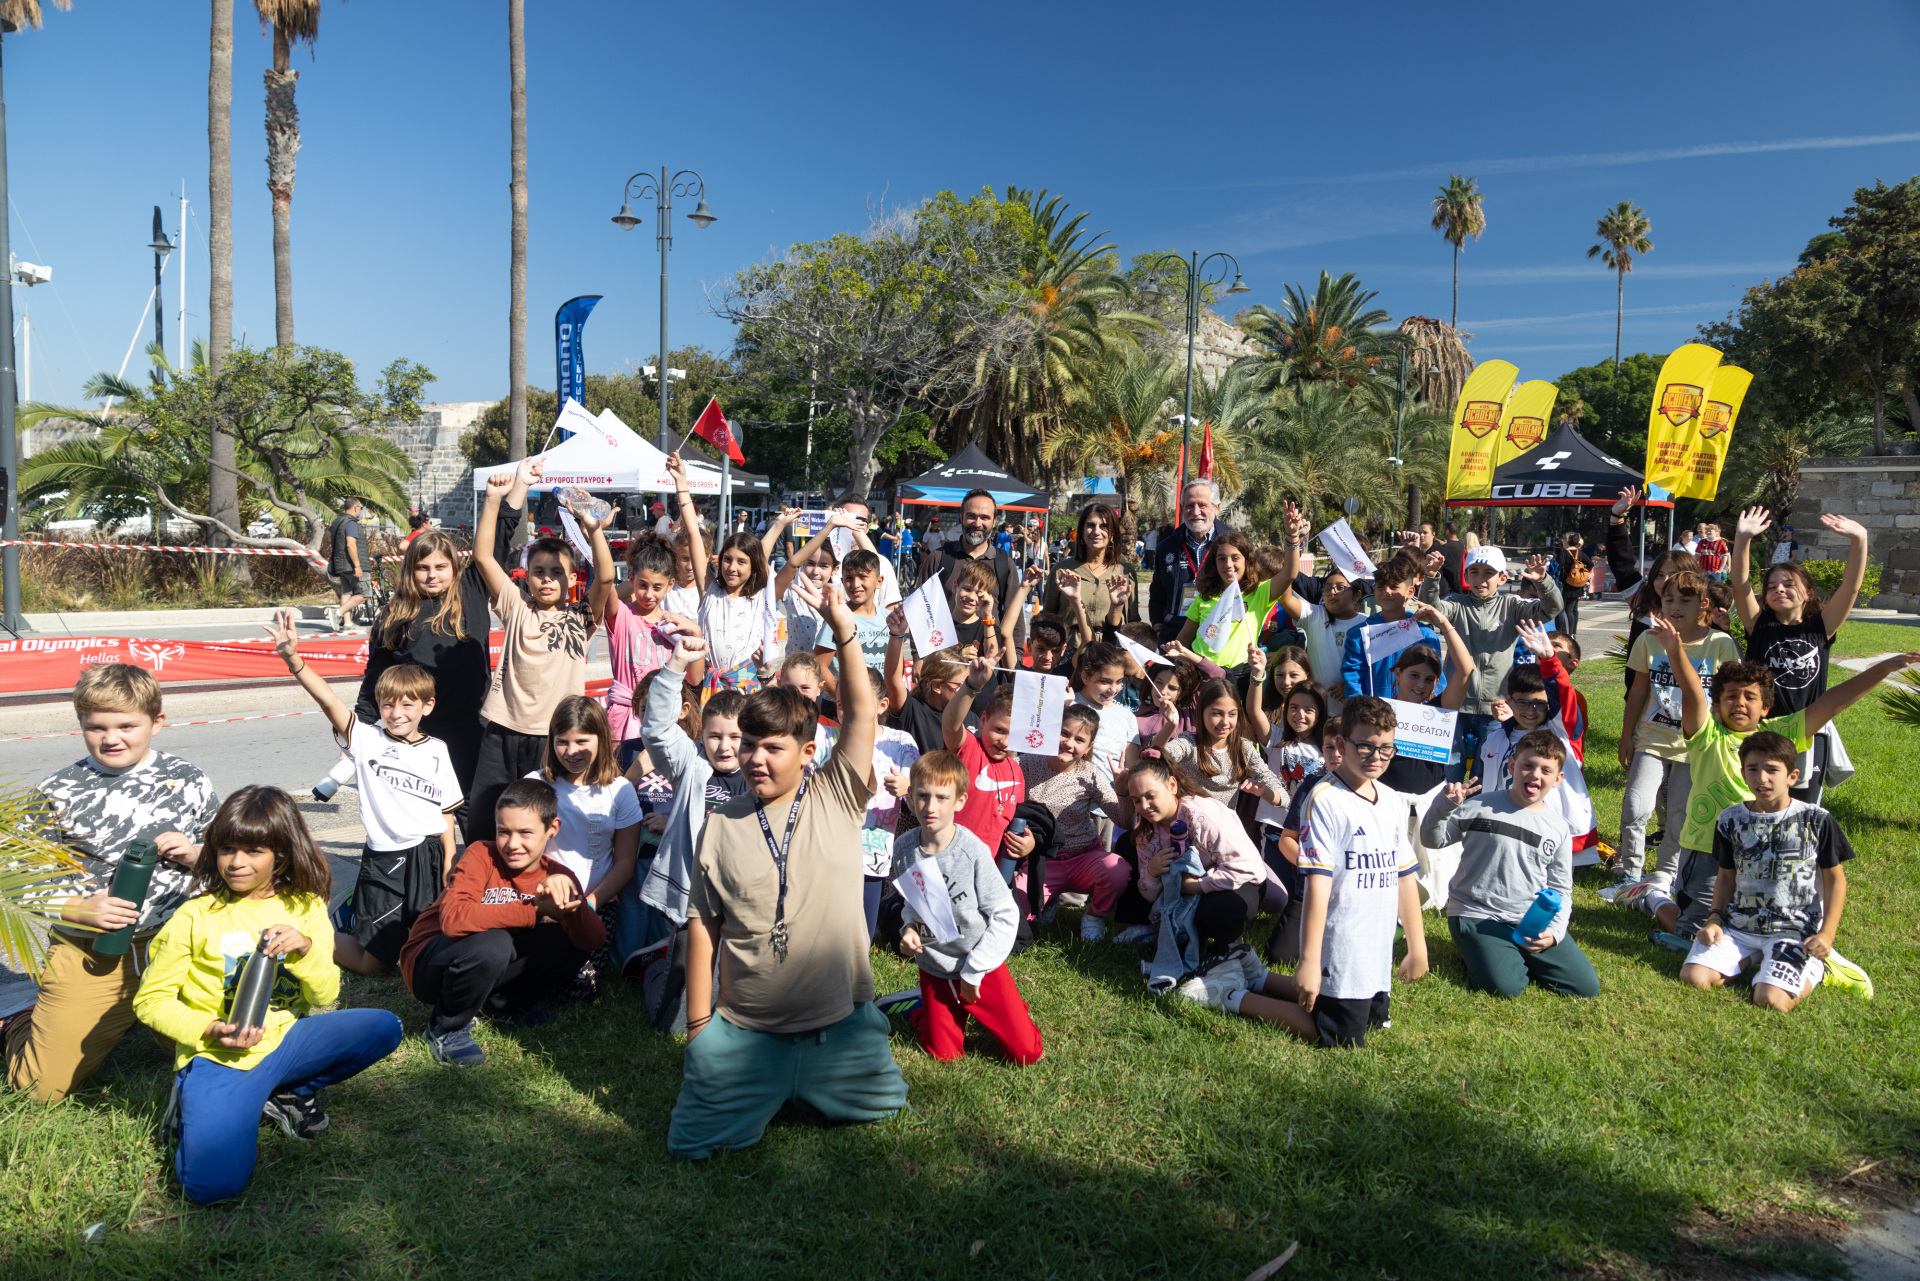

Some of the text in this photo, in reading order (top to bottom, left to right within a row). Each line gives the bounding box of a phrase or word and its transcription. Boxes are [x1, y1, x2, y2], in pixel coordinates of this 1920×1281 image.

[1662, 392, 1702, 409] ACADEMY
[1464, 408, 1500, 421] ACADEMY
[1509, 423, 1543, 436] ACADEMY
[1692, 451, 1718, 461] ΘΛΗΤΙΚΟΣ
[576, 476, 605, 484] ΣΤΑΥΡΟΣ
[955, 468, 1008, 479] CUBE
[1491, 483, 1594, 499] CUBE
[21, 636, 120, 653] Olympics
[79, 652, 120, 665] Hellas
[1516, 654, 1536, 665] adi
[1768, 656, 1817, 670] NASA
[1035, 675, 1047, 728] Special Olympics
[1411, 724, 1451, 738] ΘΕΑΤΩΝ
[1357, 872, 1376, 889] FLY
